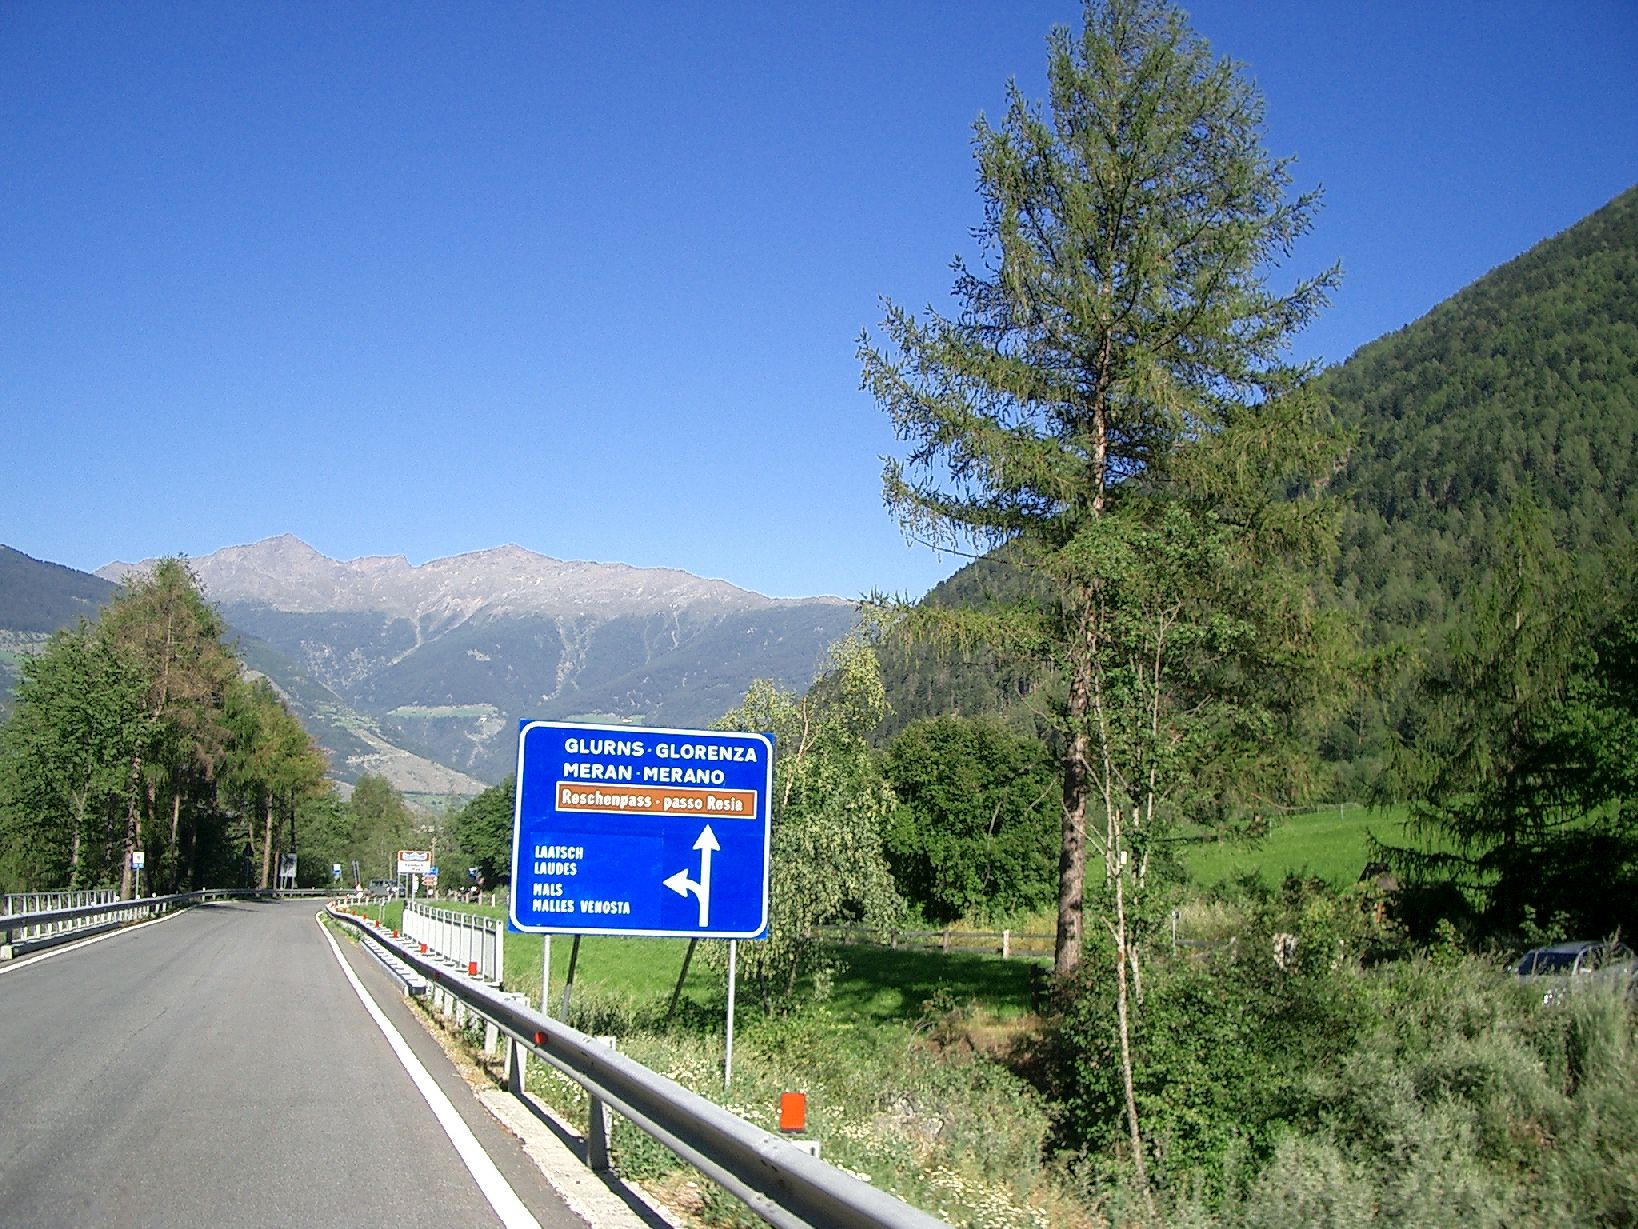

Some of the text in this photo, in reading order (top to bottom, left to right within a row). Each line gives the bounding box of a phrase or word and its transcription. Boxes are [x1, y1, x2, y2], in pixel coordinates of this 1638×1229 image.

[563, 738, 758, 763] GLURNS GLORENZA
[563, 762, 726, 786] MERAN MERANO
[561, 788, 744, 812] Reschenpass passo Resia
[534, 845, 584, 861] LAATSCH
[533, 861, 578, 877] LAUDES
[532, 883, 564, 897] MALS
[532, 898, 631, 915] MALLES VENOSTA
